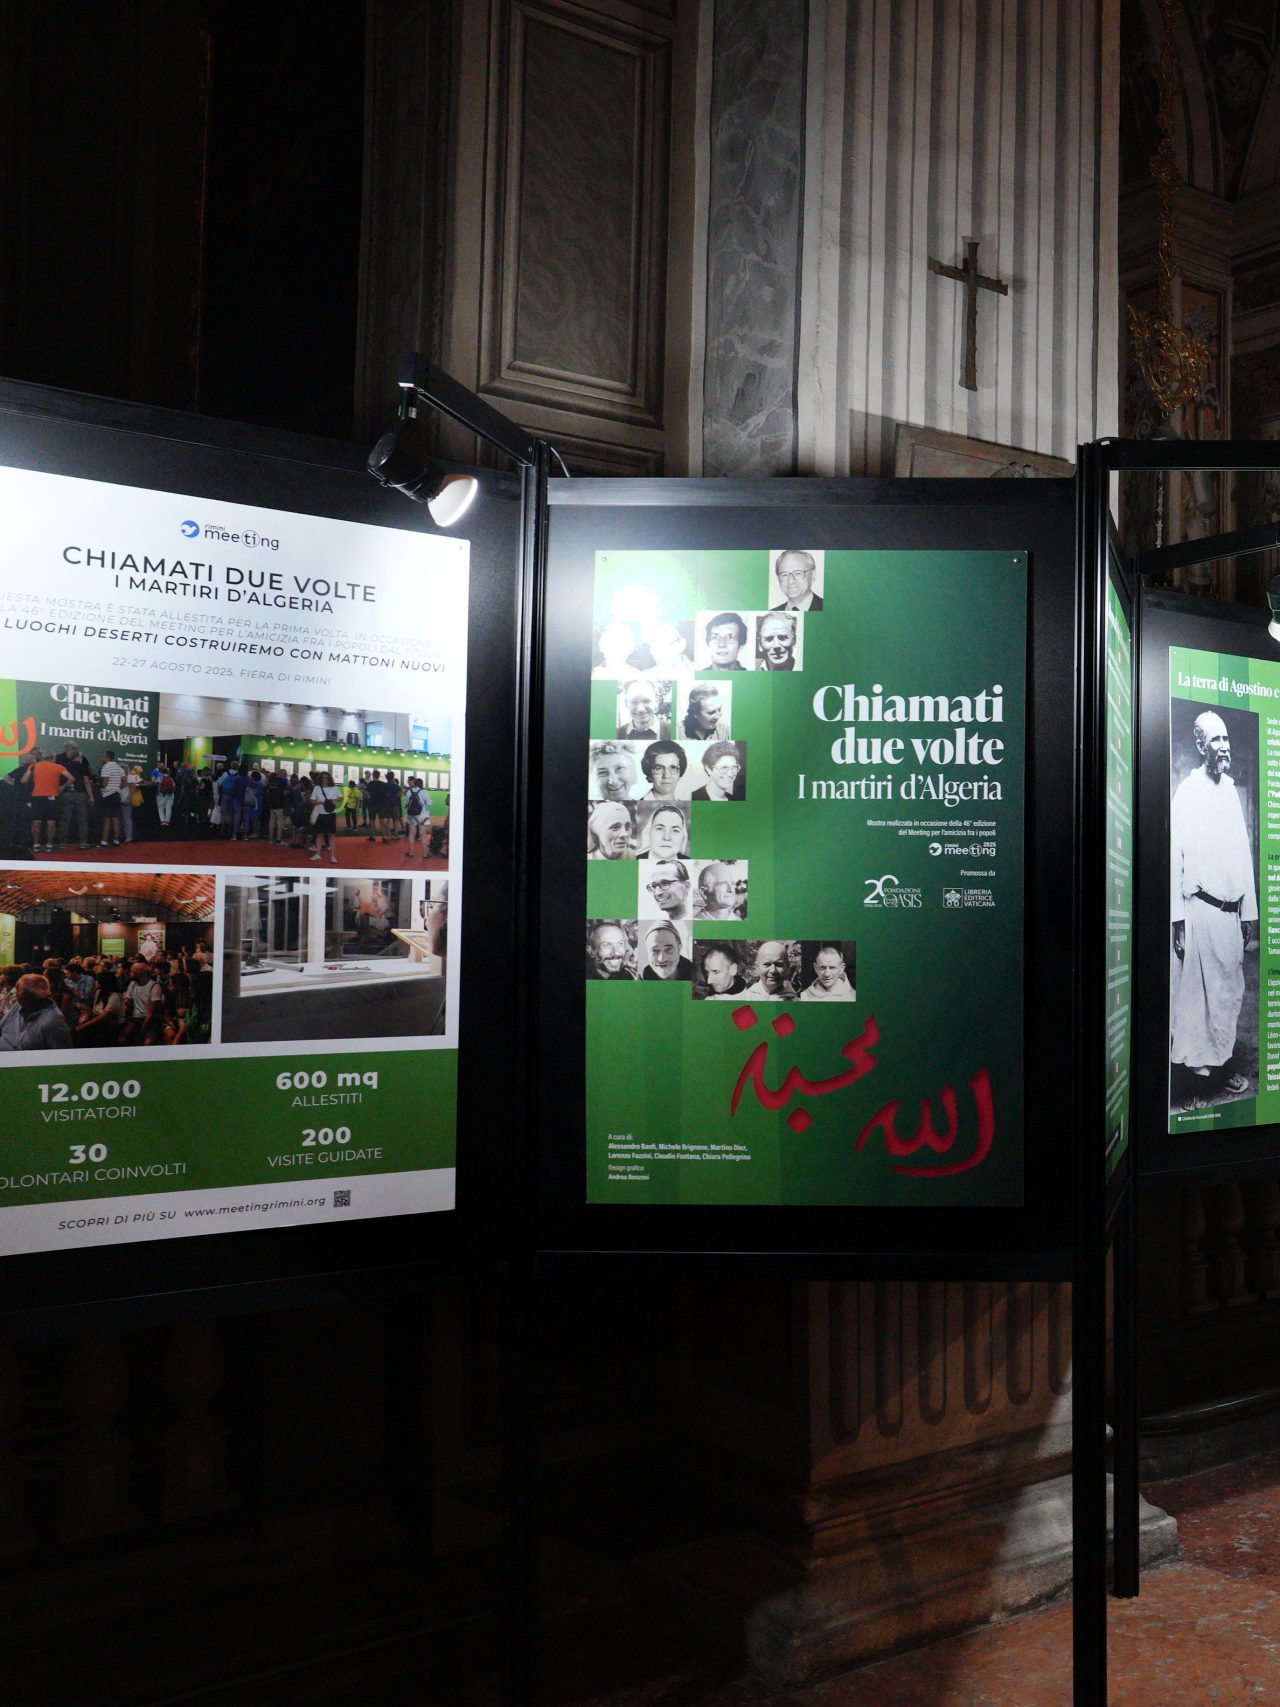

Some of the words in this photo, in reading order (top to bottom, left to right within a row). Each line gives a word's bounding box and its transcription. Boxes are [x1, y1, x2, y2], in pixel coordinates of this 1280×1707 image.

[204, 528, 280, 550] meeting
[63, 546, 212, 582] CHIAMATI
[226, 567, 283, 591] DUE
[294, 576, 376, 602] VOLTE
[116, 575, 119, 588] I
[130, 577, 218, 600] MARTIRI
[228, 589, 333, 614] D'ALGERIA
[45, 597, 101, 610] MOSTRA
[118, 605, 156, 617] STATA
[160, 611, 223, 624] ALLESTITA
[228, 618, 252, 628] PER
[255, 621, 269, 630] LA
[273, 623, 310, 634] PRIMA
[314, 628, 348, 638] VOLTA
[49, 609, 115, 624] EDIZIONE
[120, 617, 144, 628] DEL
[149, 620, 206, 634] MEETING
[210, 627, 234, 636] PER
[238, 630, 299, 643] L'AMICIZIA
[303, 637, 324, 646] FRA
[5, 618, 77, 635] LUOGHI
[84, 627, 158, 644] DESERTI
[165, 635, 284, 656] COSTRUIREMO
[290, 649, 323, 660] CON
[329, 653, 395, 668] MATTONI
[401, 660, 445, 672] NUOVI
[112, 657, 147, 668] 22-27
[150, 661, 202, 673] AGOSTO
[240, 669, 274, 680] FIERA
[278, 673, 291, 682] DI
[294, 675, 331, 685] RIMINI
[1178, 671, 1191, 688] La
[1192, 674, 1218, 691] terra
[1218, 677, 1229, 692] di
[1230, 680, 1273, 698] Agostino
[1274, 688, 1280, 698] e
[50, 684, 149, 713] Chiamati
[813, 684, 1003, 722] Chiamati
[60, 705, 101, 724] due
[104, 710, 149, 729] volte
[41, 723, 46, 736] I
[49, 727, 94, 742] martiri
[98, 729, 148, 746] d'Algeria
[831, 727, 904, 764] due
[912, 727, 1004, 765] volte
[798, 775, 805, 799] I
[812, 774, 892, 799] martiri
[900, 774, 1001, 807] d'Algeria
[945, 844, 996, 856] meeting
[38, 1080, 141, 1103] 12.000
[276, 1071, 328, 1090] 600
[338, 1072, 378, 1089] mq
[292, 1093, 362, 1107] ALLESTITI
[41, 1106, 136, 1122] VISITATORI
[302, 1126, 351, 1146] 200
[69, 1144, 108, 1164] 30
[268, 1153, 314, 1167] VISITE
[318, 1148, 382, 1163] GUIDATE
[95, 1163, 186, 1181] COINVOLTI
[58, 1217, 110, 1230] SCOPRI
[114, 1216, 128, 1224] DI
[133, 1211, 156, 1222] PIÙ
[160, 1211, 176, 1220] SU
[185, 1198, 326, 1217] www.meetingrimini.org
